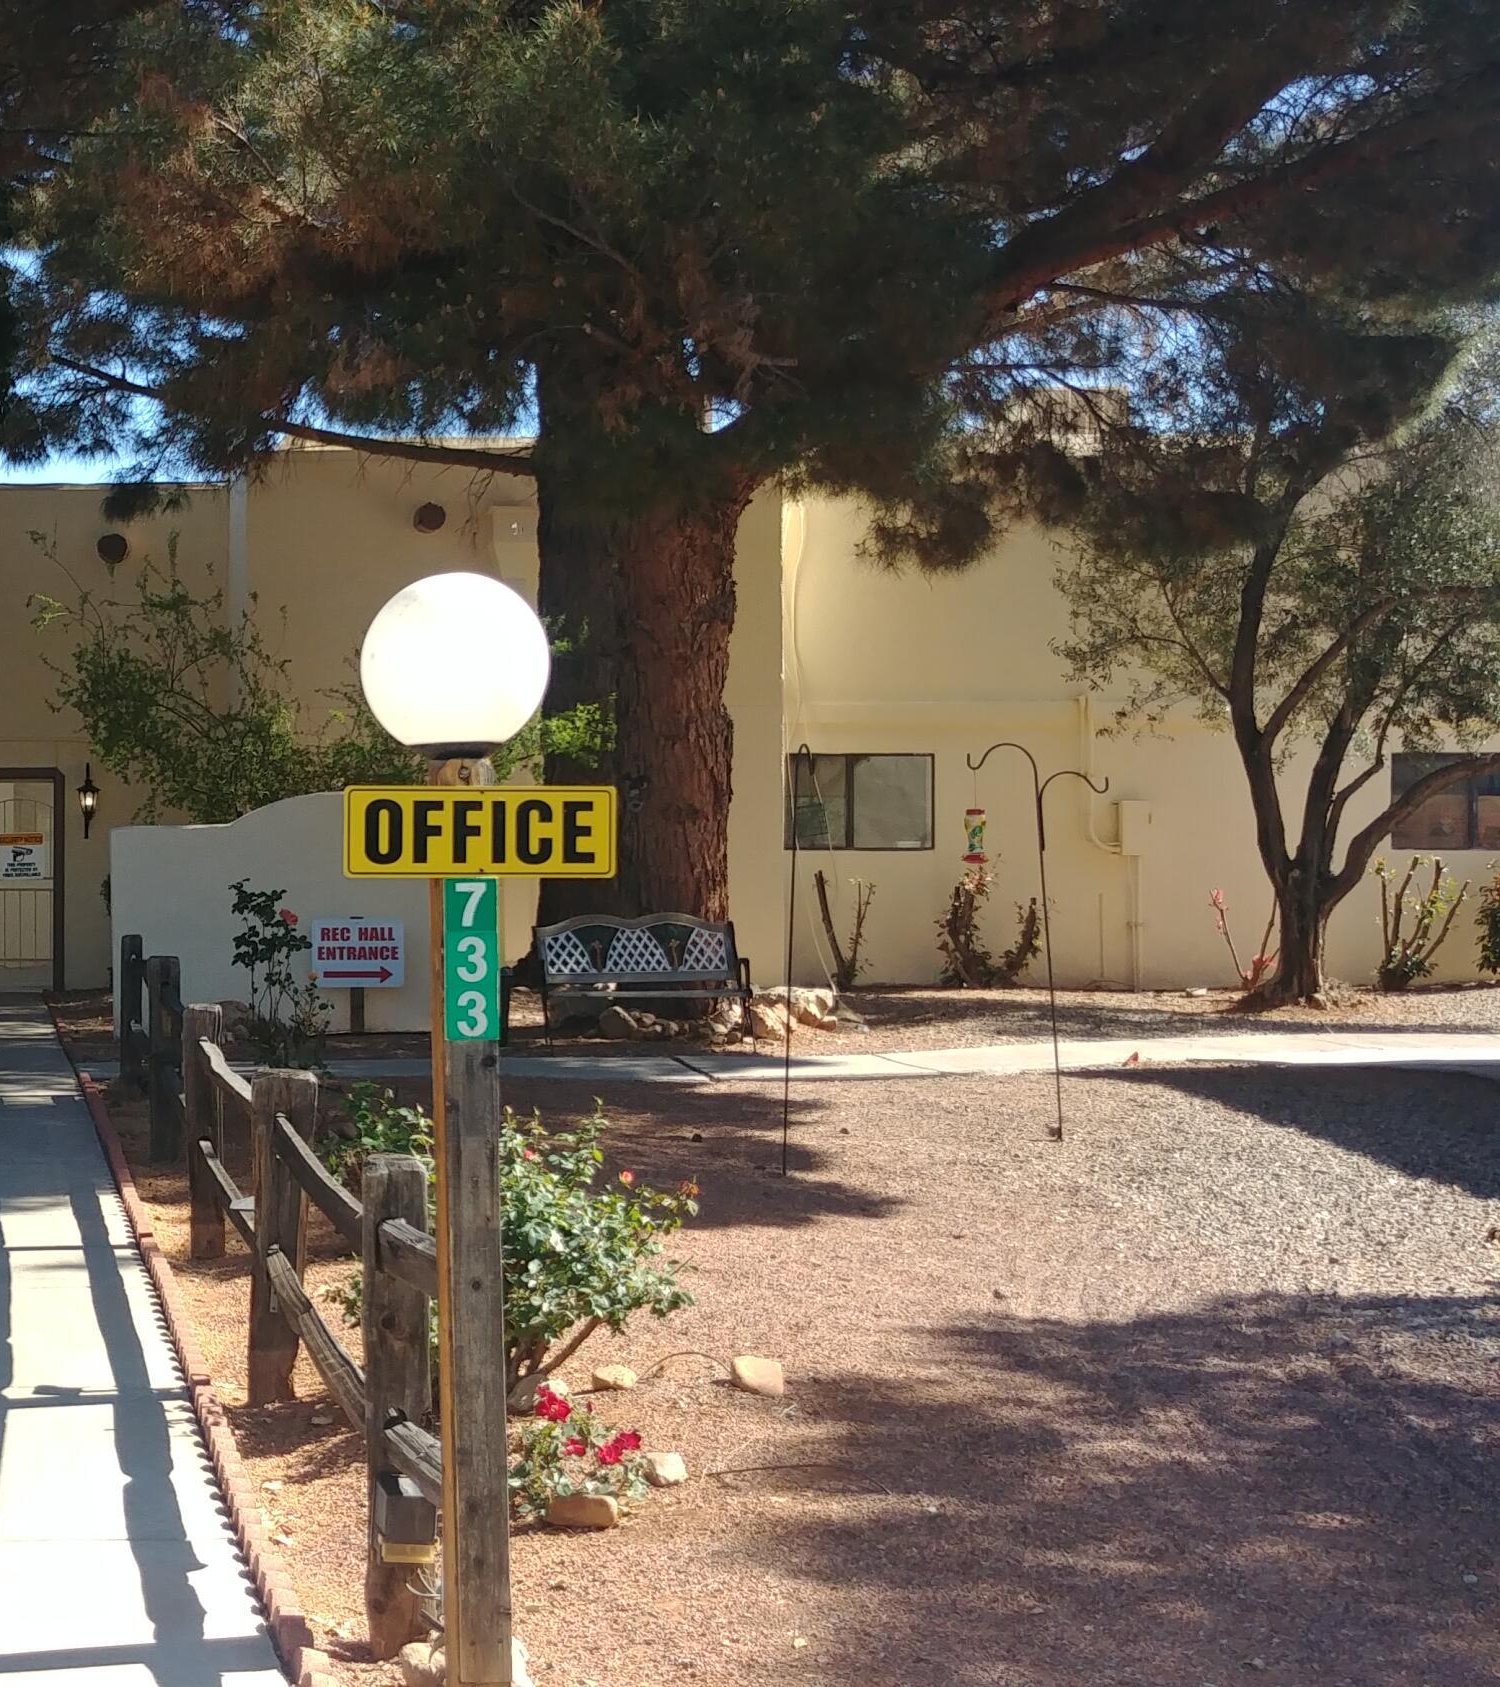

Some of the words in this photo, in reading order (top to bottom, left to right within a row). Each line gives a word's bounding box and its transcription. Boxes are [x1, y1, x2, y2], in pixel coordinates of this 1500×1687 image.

[364, 799, 596, 865] OFFICE
[317, 946, 399, 960] ENTRANCE
[320, 927, 351, 941] REC
[358, 927, 396, 941] HALL
[455, 882, 488, 1038] 733
